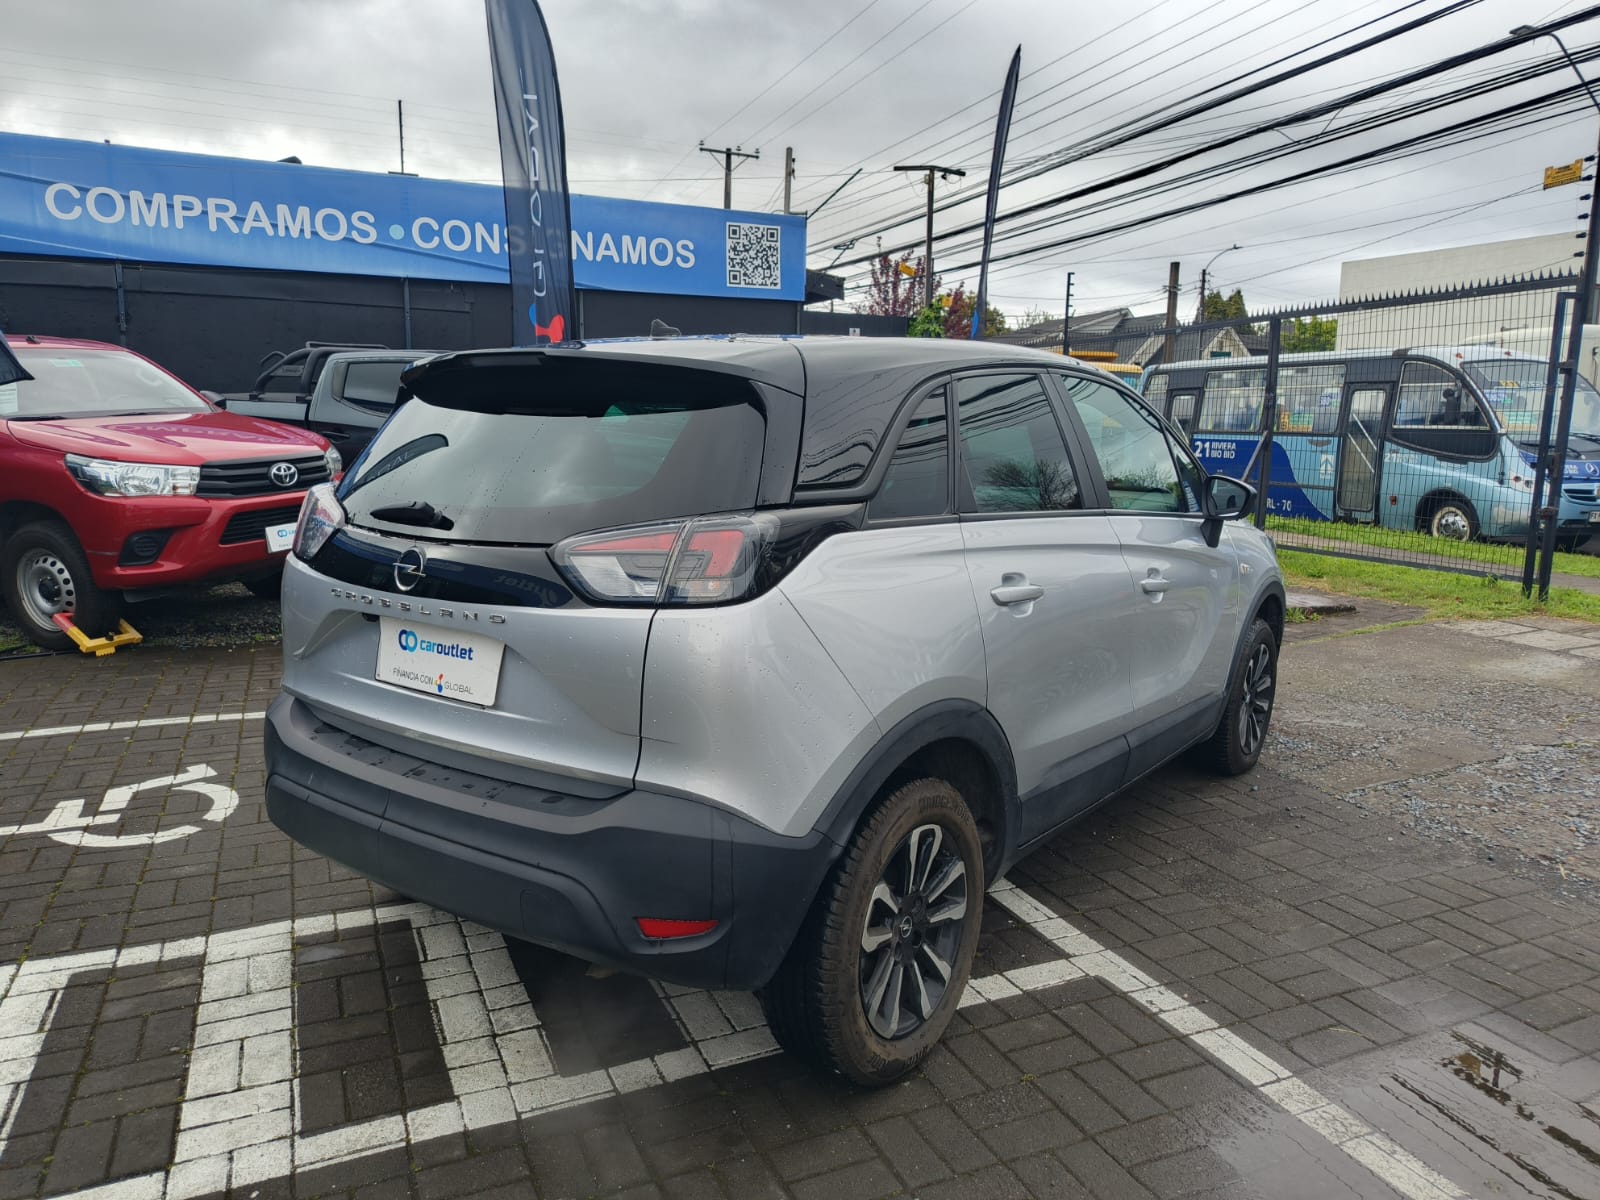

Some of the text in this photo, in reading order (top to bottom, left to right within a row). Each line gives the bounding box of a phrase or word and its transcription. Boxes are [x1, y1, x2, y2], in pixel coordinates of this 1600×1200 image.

[45, 183, 377, 244] COMPRAMOS
[1194, 441, 1211, 458] 21
[331, 588, 506, 624] CROSSLAND
[420, 640, 474, 661] caroutlet
[419, 674, 434, 685] CON
[444, 681, 473, 695] GLOBAL
